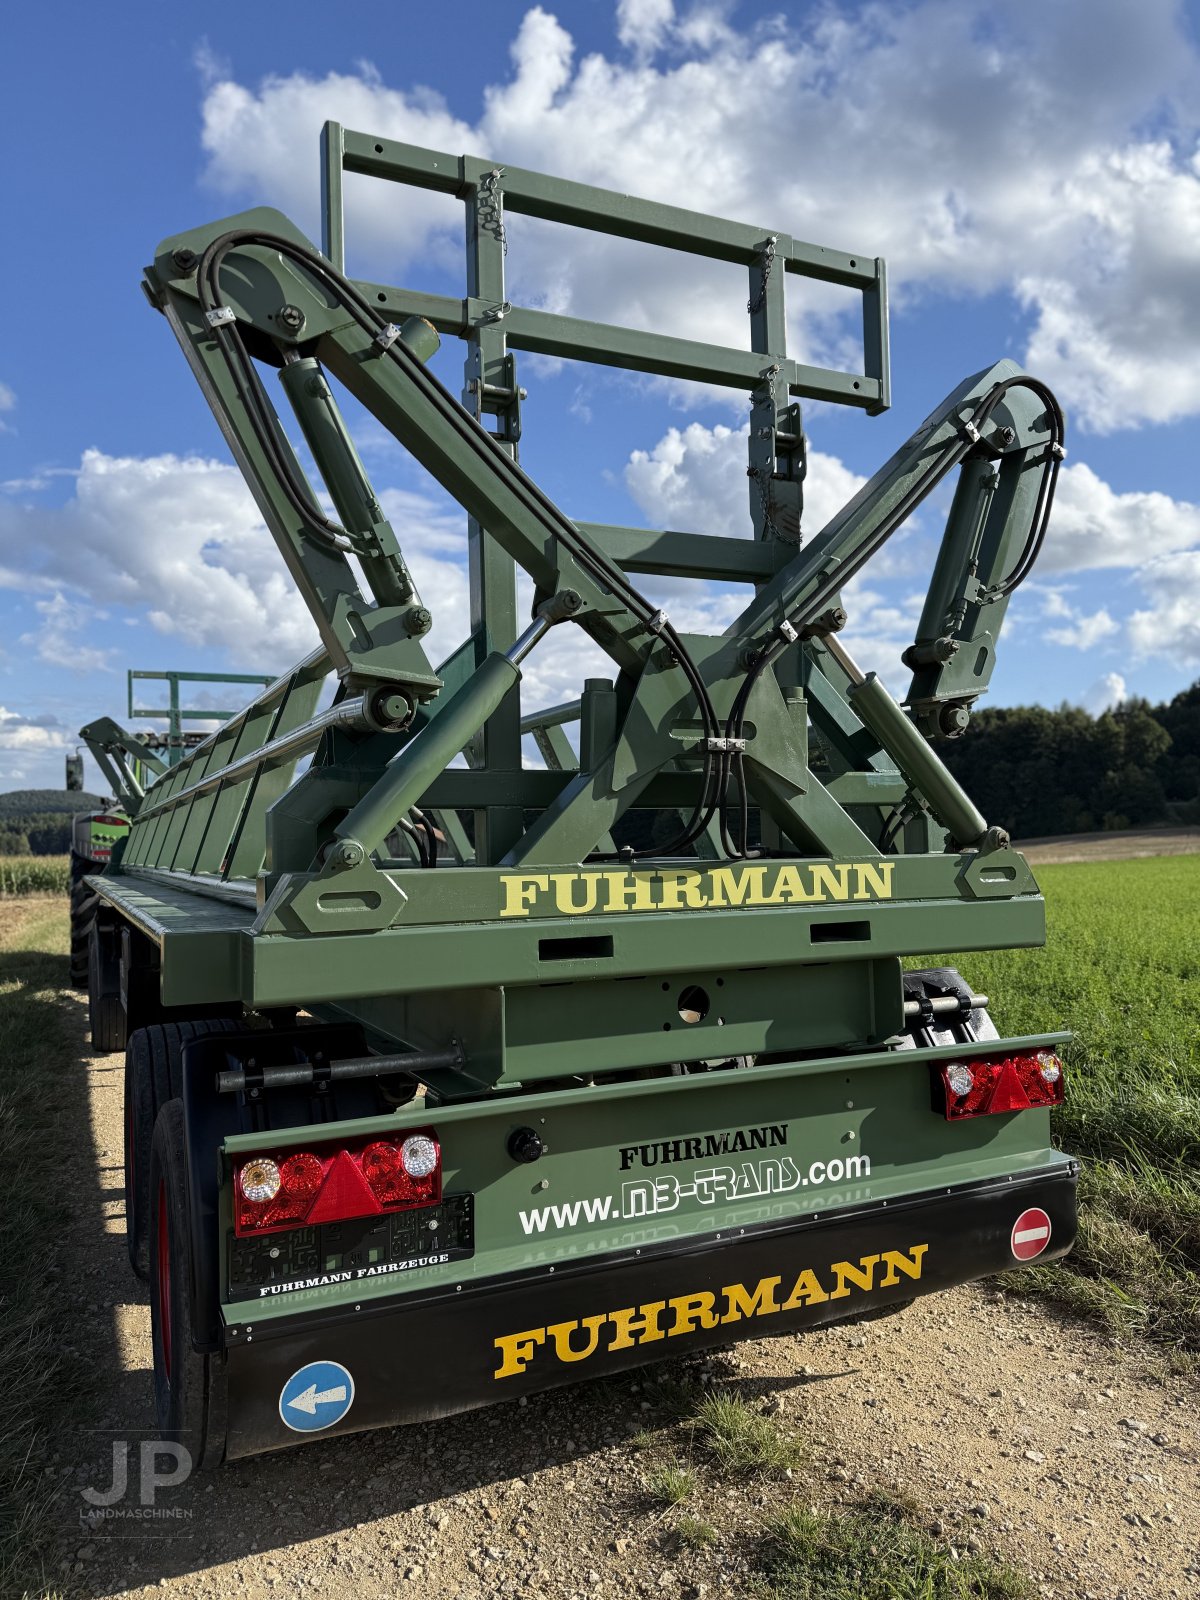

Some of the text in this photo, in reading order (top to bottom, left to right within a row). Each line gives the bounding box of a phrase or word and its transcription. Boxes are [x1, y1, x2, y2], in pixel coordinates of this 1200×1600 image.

[500, 863, 895, 917] FUHRMANN
[619, 1124, 788, 1171] FUHRMANN
[259, 1253, 449, 1297] FUHRMANN FAHRZEUGE
[493, 1244, 929, 1379] FUHRMANN
